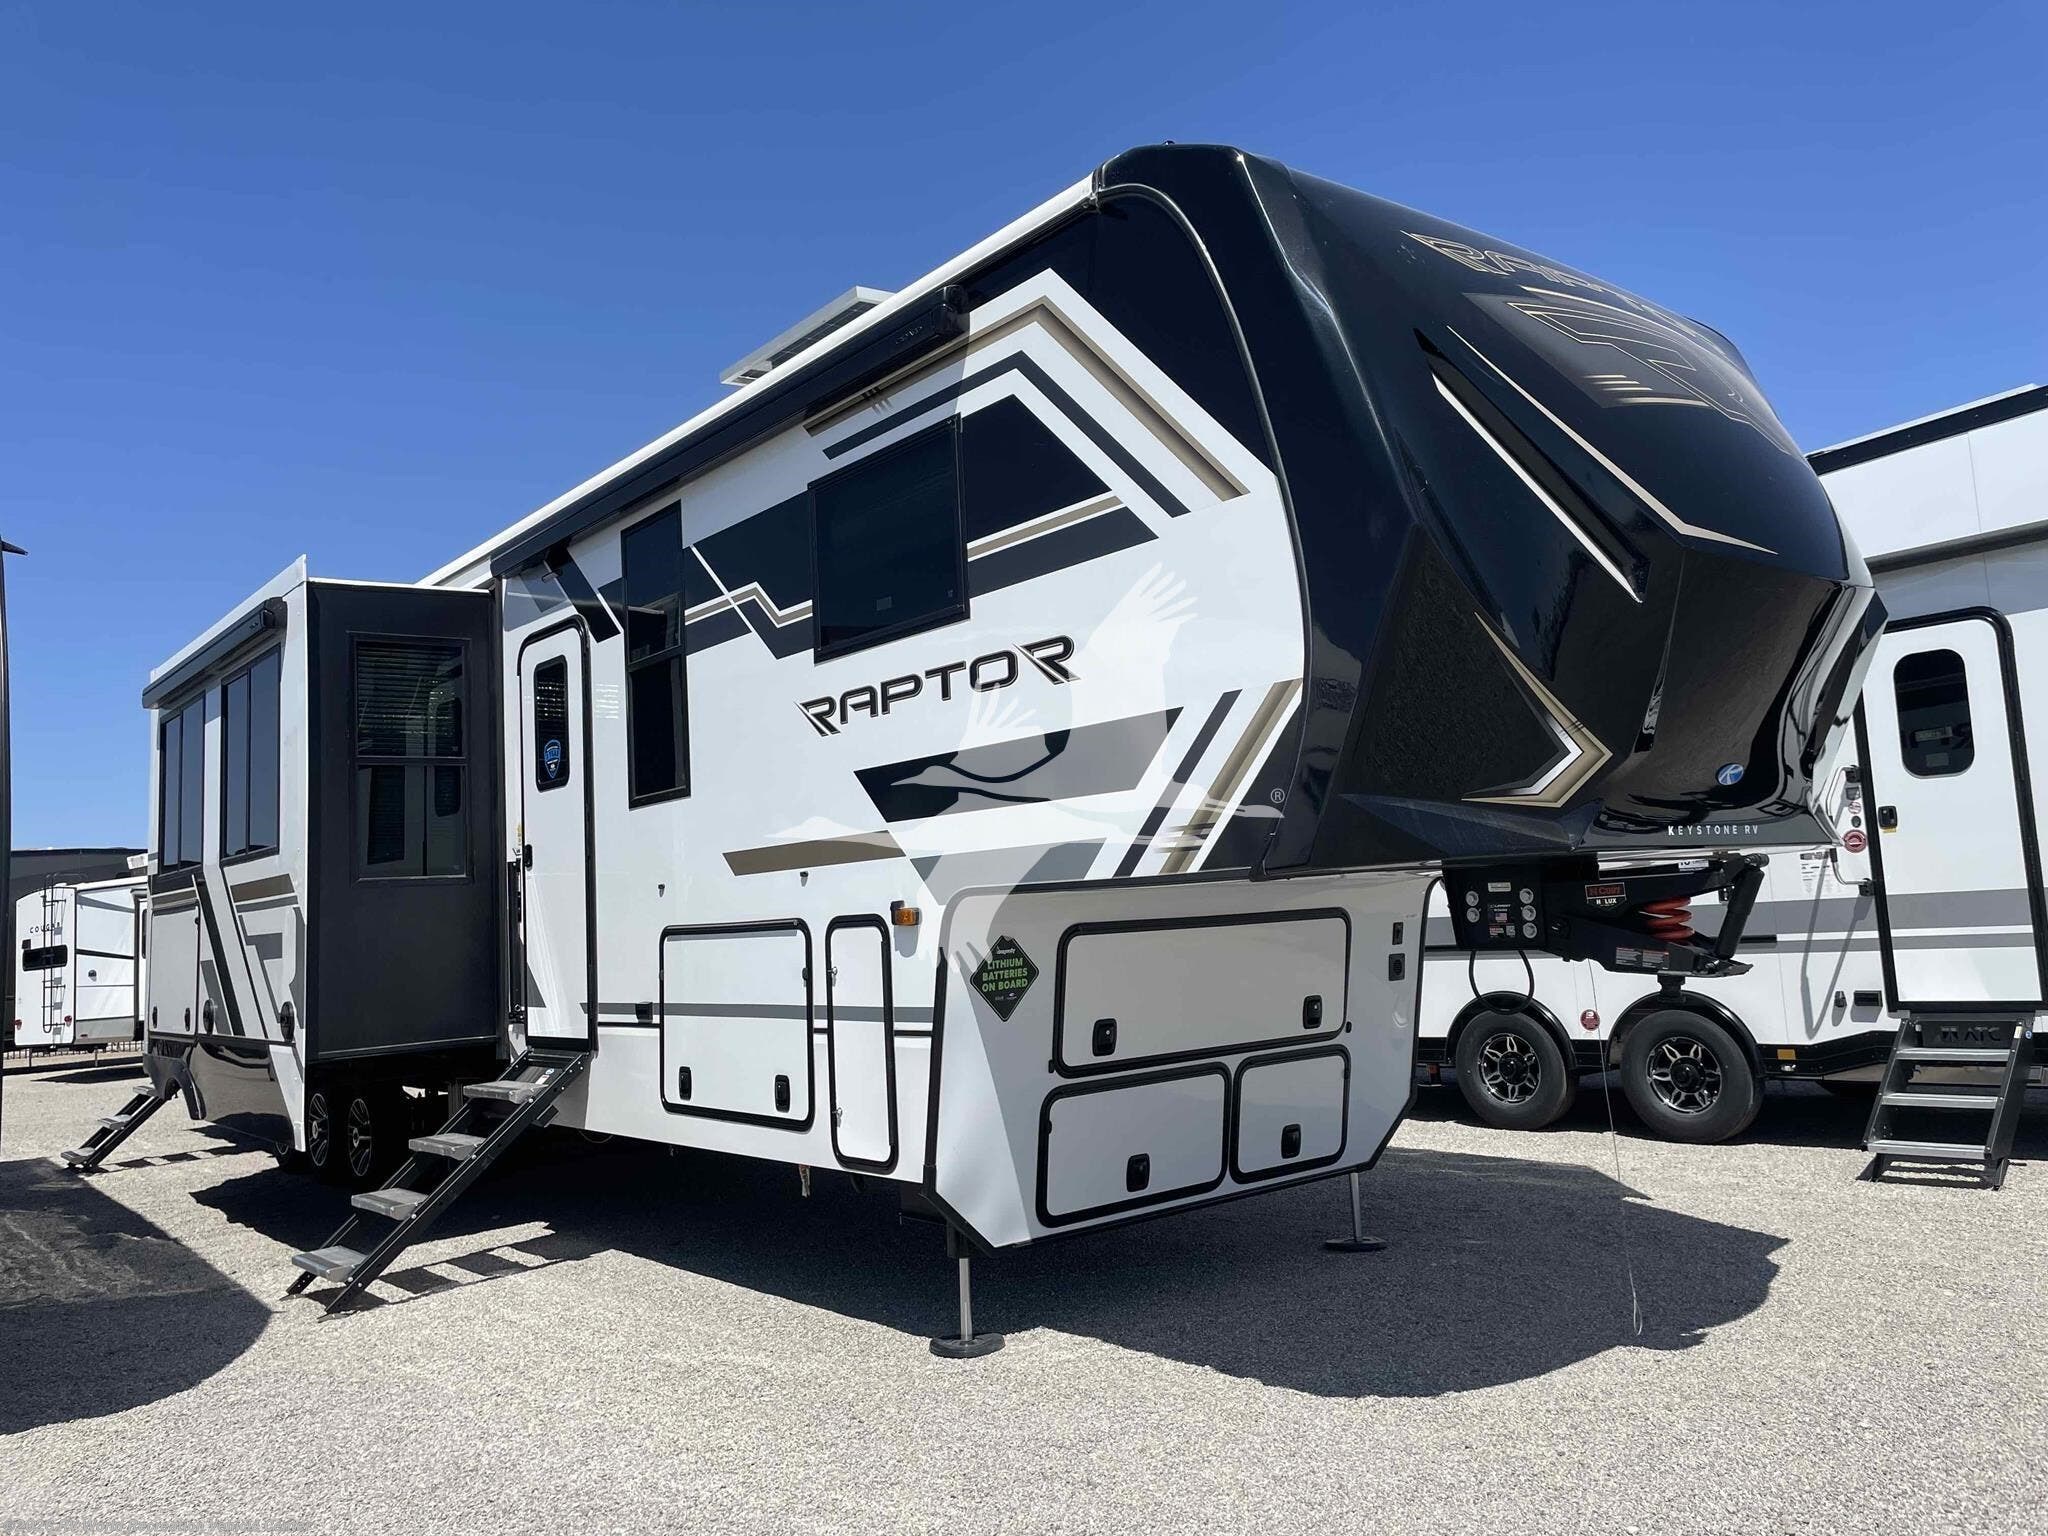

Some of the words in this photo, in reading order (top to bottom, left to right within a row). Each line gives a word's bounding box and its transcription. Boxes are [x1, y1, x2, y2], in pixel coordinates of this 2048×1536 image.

[795, 634, 1081, 737] RAPTOR
[1667, 824, 1738, 836] KEYSTONE
[1744, 824, 1758, 835] RV
[987, 957, 1023, 969] LITHIUM
[982, 968, 1028, 981] BATTERIES
[982, 982, 996, 992] ON
[998, 978, 1028, 990] BOARD
